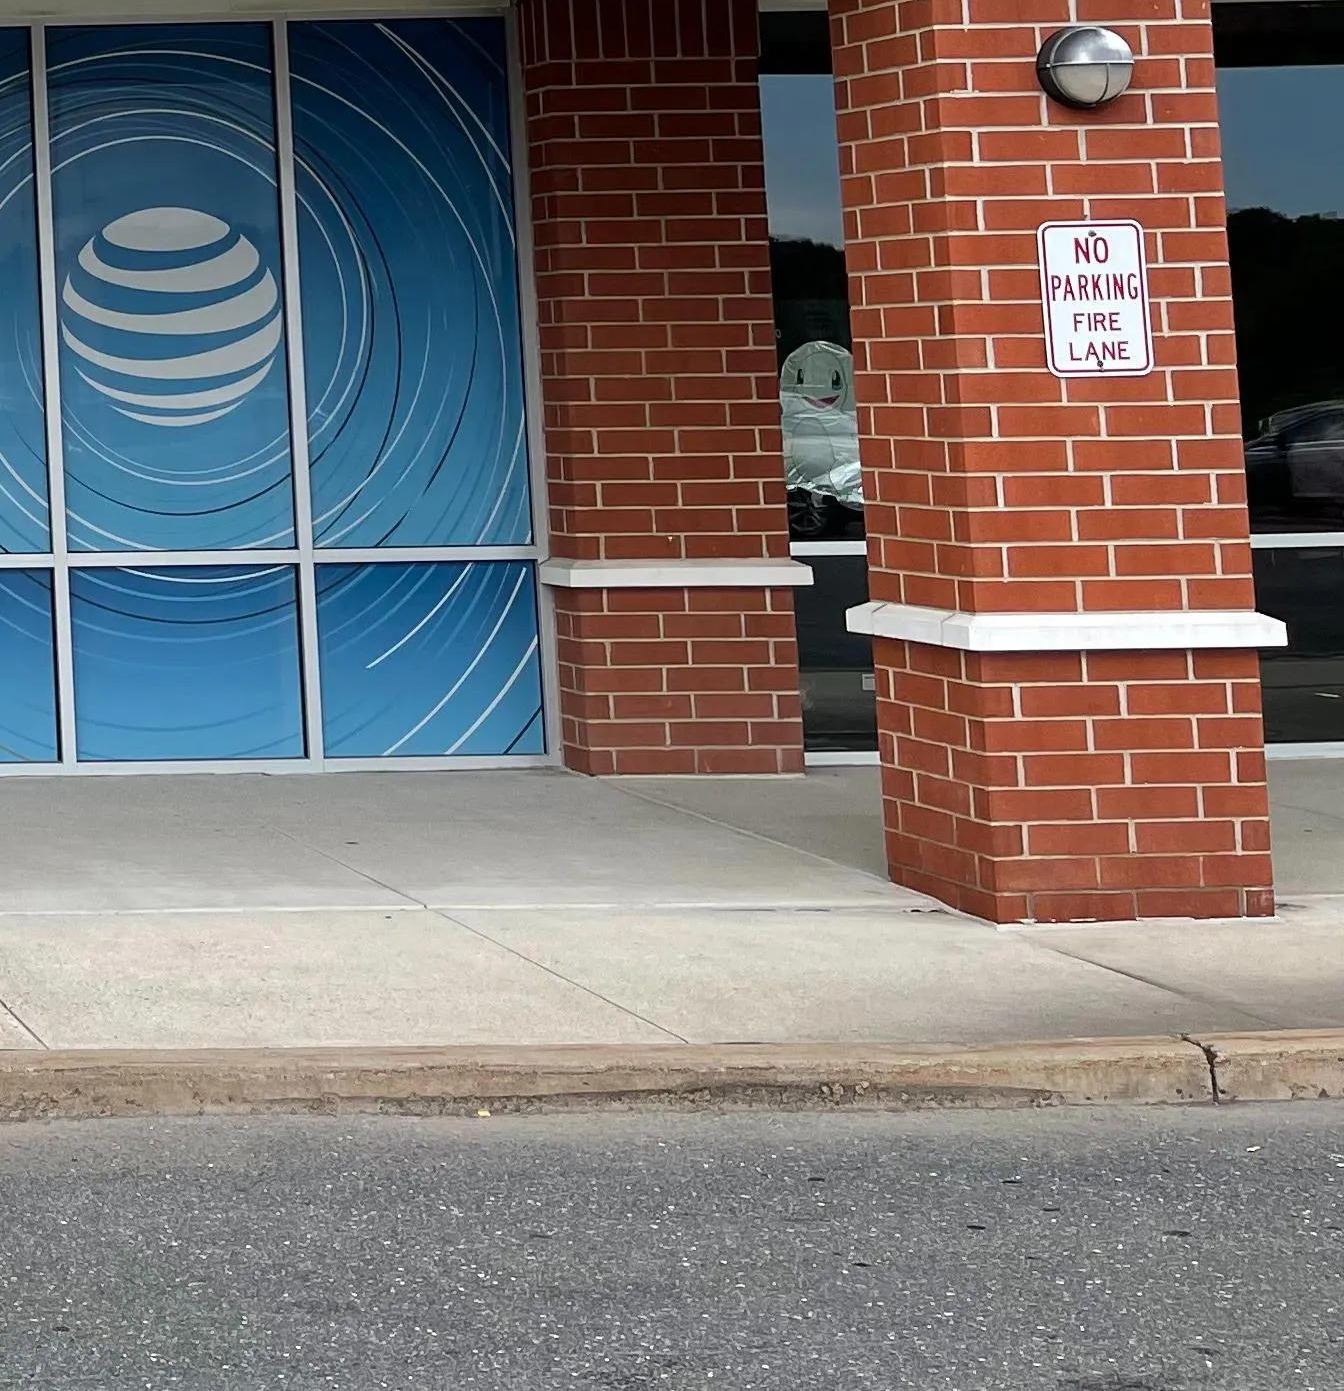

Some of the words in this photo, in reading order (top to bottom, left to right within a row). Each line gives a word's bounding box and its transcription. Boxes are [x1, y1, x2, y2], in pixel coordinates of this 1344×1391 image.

[1074, 237, 1108, 264] NO
[1051, 273, 1139, 301] PARKING
[1074, 312, 1122, 332] FIRE
[1069, 341, 1130, 361] LANE
